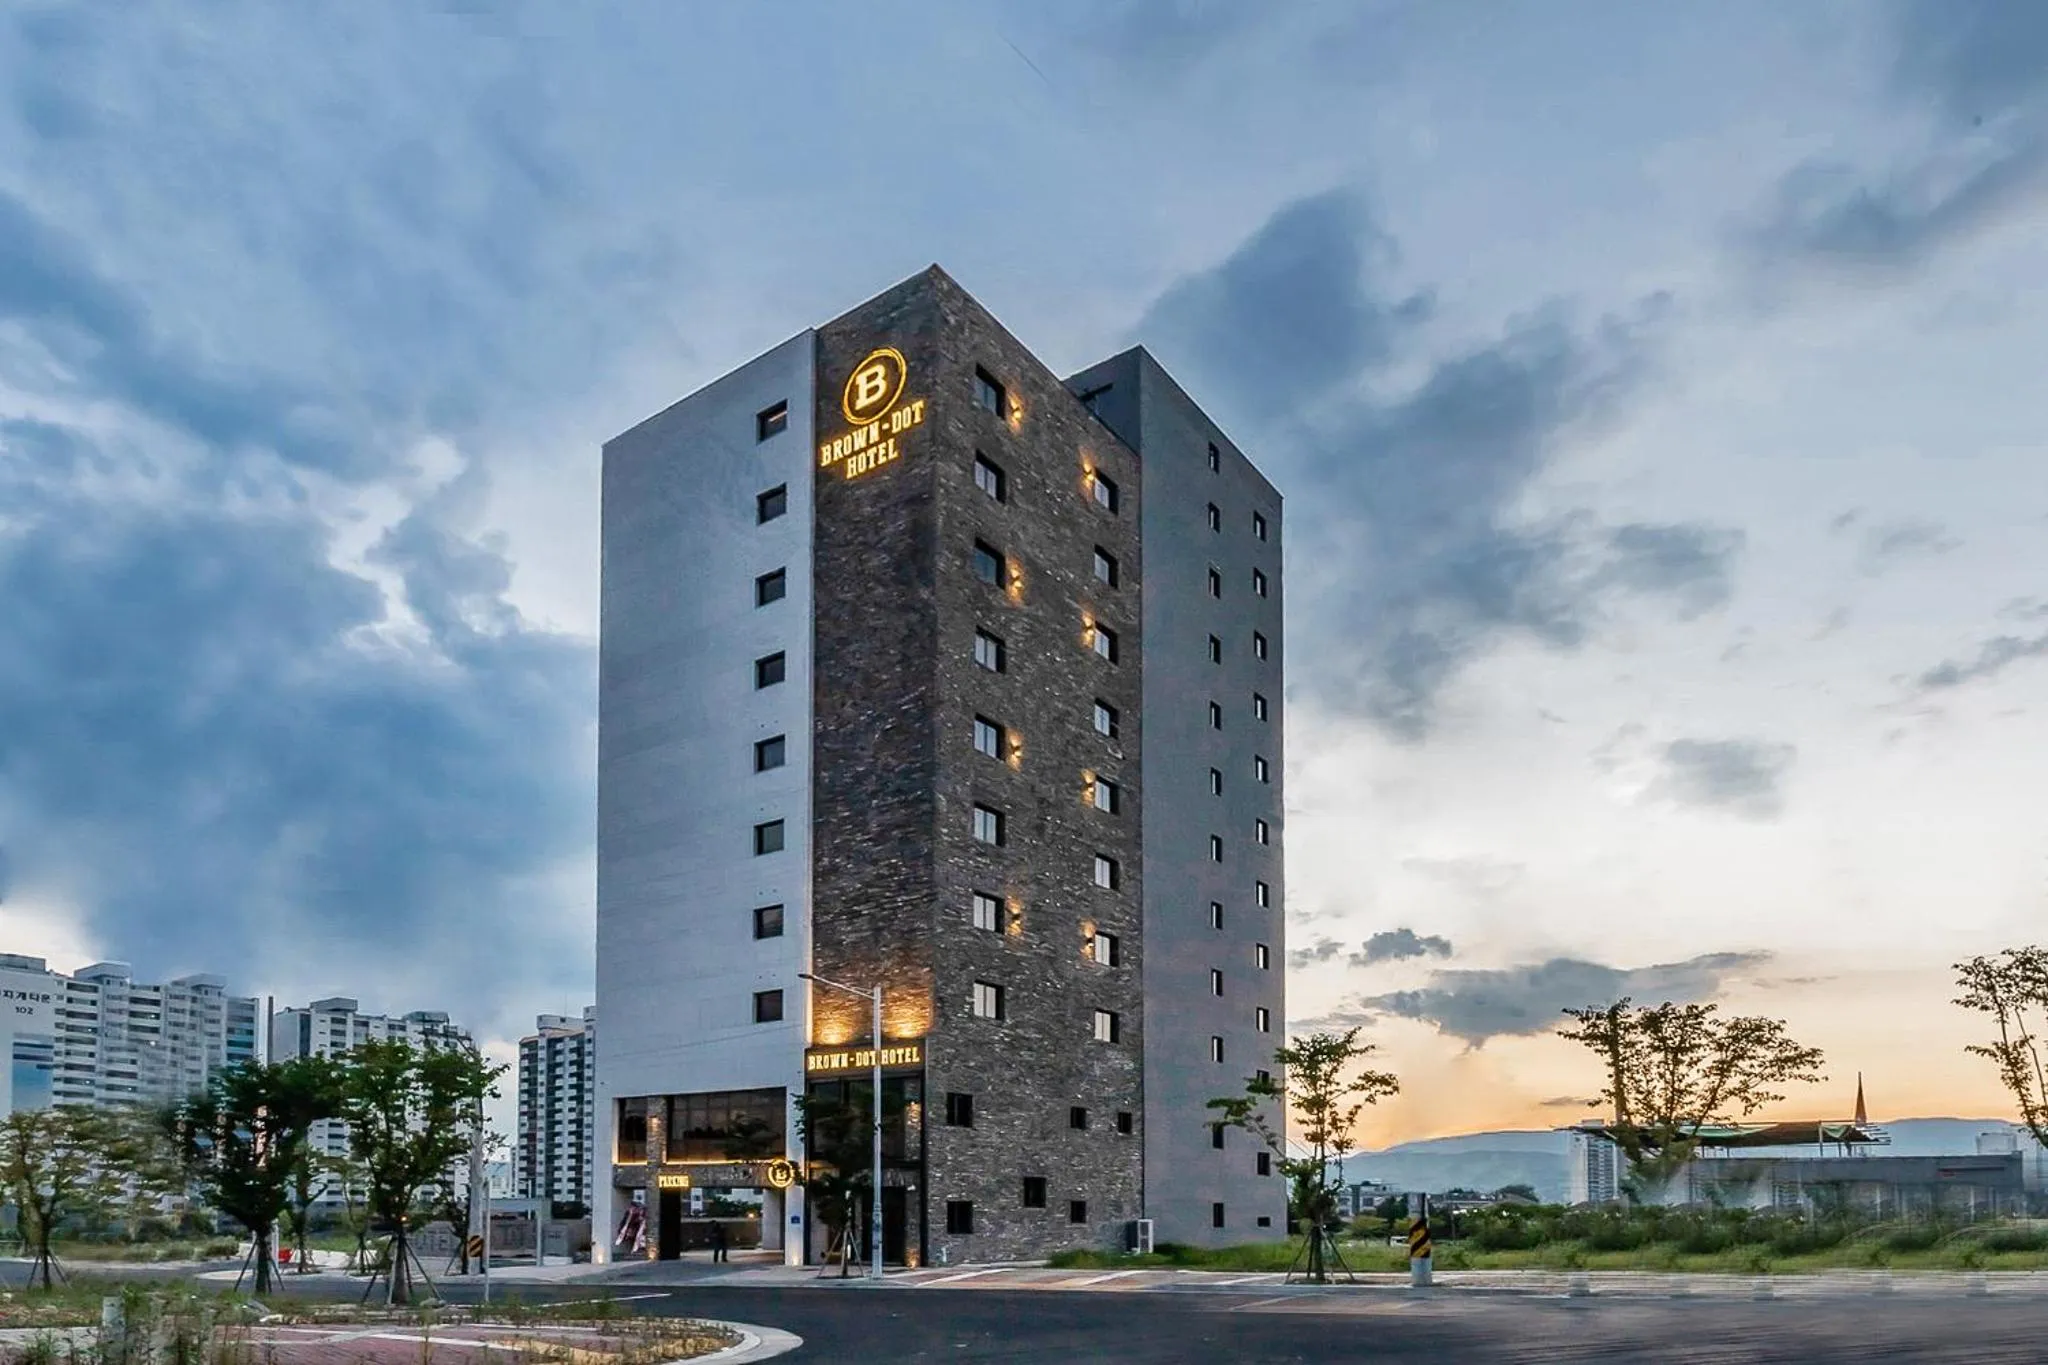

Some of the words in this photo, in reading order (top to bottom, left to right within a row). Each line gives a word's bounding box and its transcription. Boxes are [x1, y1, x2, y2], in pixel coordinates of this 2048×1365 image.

[855, 364, 887, 410] B
[846, 438, 898, 479] HOTEL
[0, 990, 50, 1004] 지개타운
[15, 1006, 34, 1015] 102
[881, 1047, 920, 1065] HOTEL
